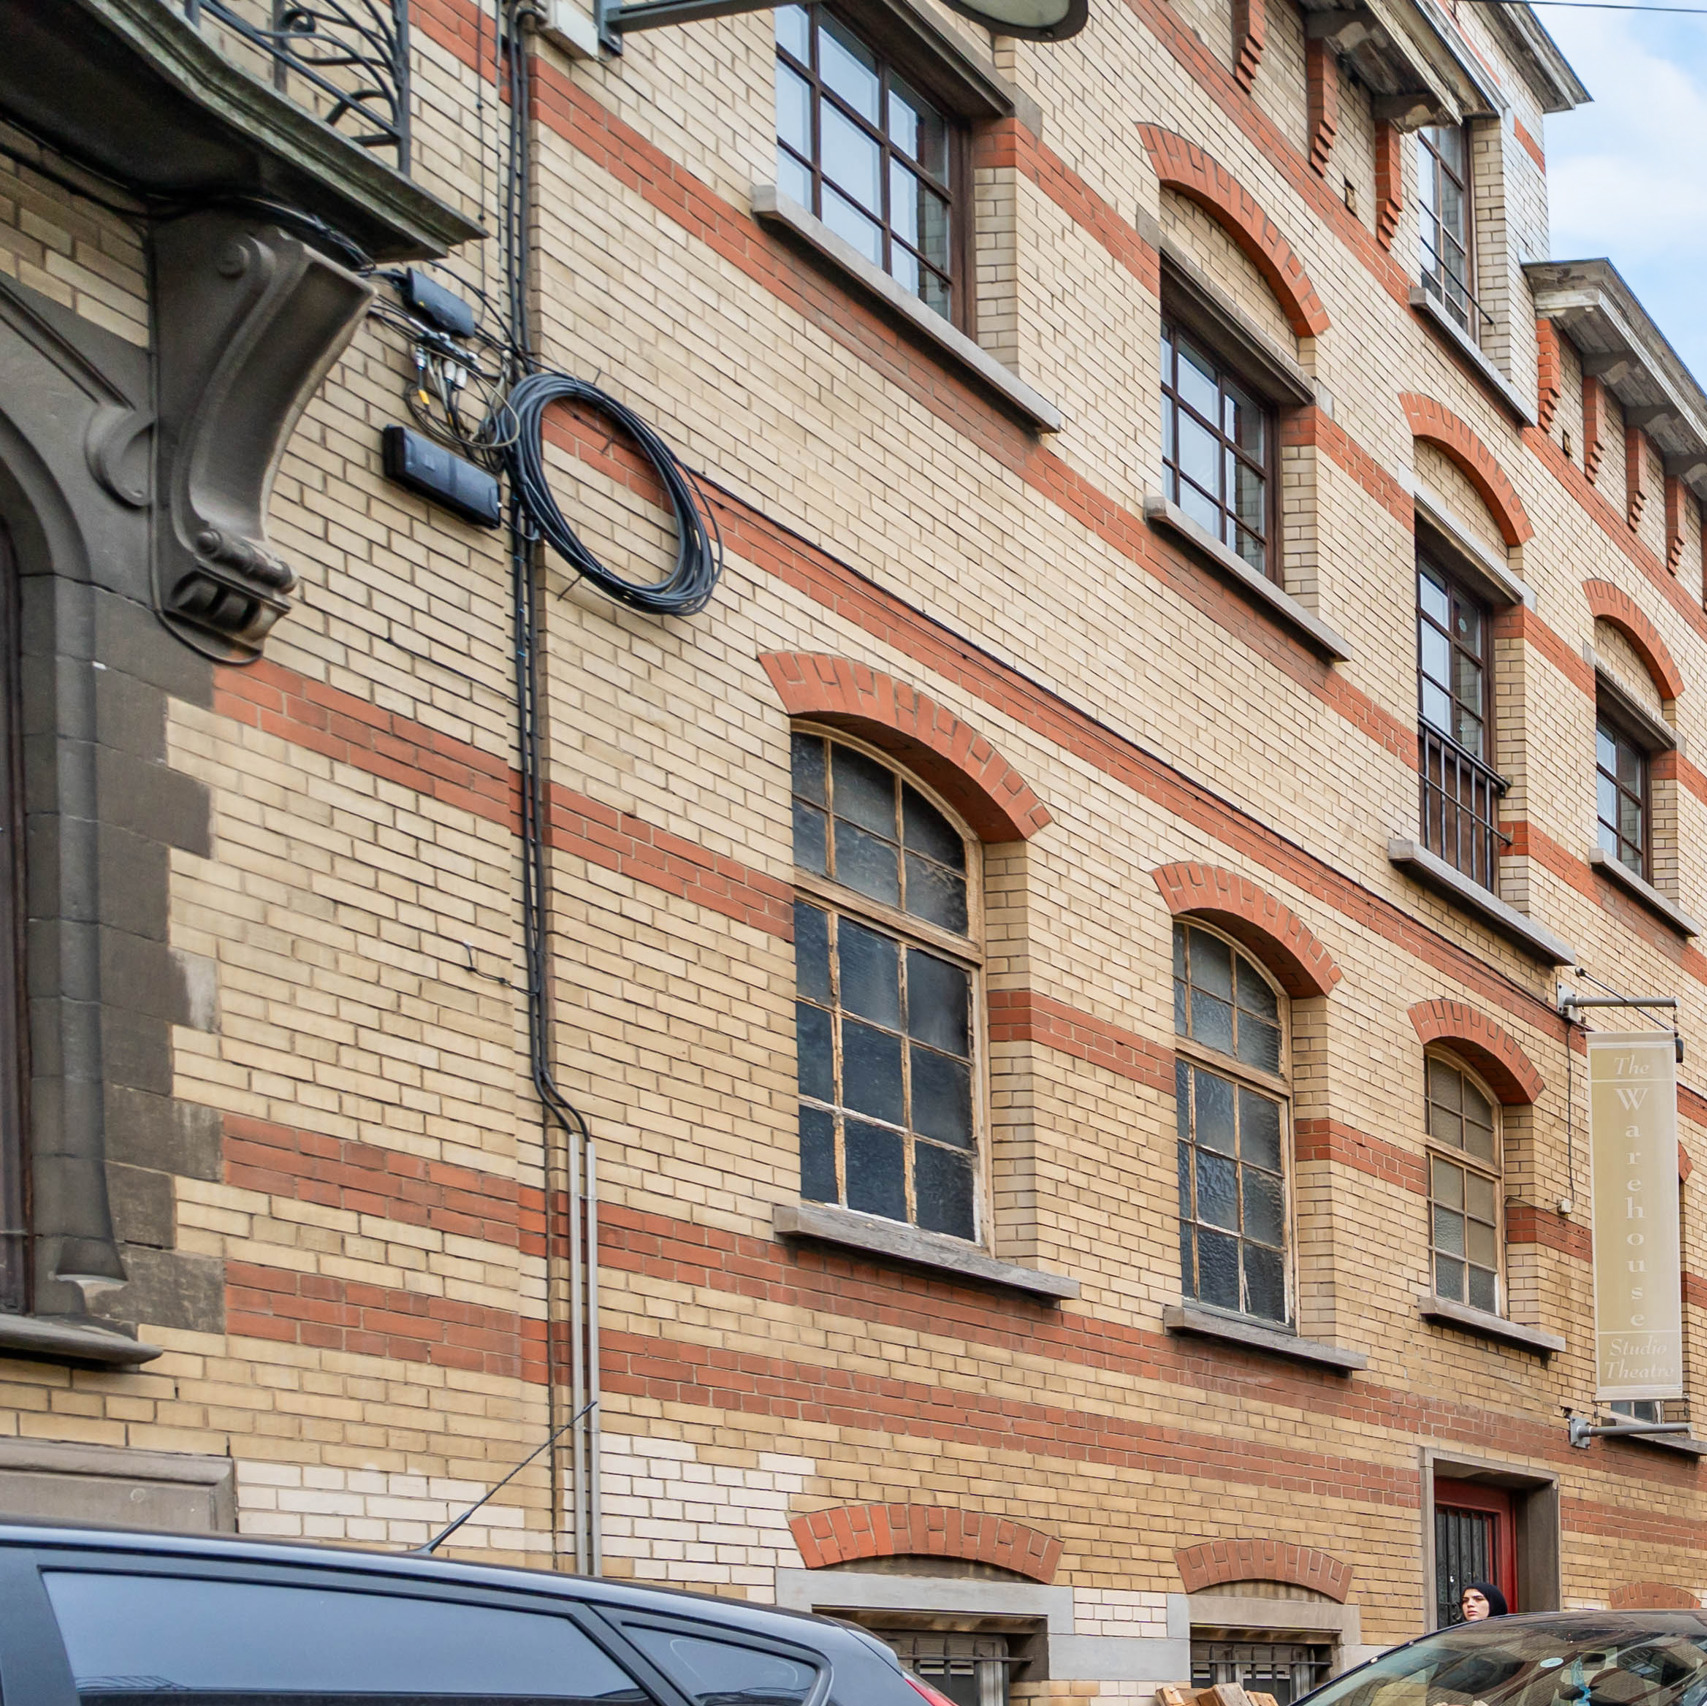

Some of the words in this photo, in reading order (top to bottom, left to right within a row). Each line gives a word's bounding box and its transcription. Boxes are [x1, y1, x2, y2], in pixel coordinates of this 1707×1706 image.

[1613, 1056, 1650, 1077] The
[1615, 1087, 1649, 1328] Warehouse
[1608, 1335, 1668, 1357] Studio
[1604, 1358, 1675, 1379] Theatre
